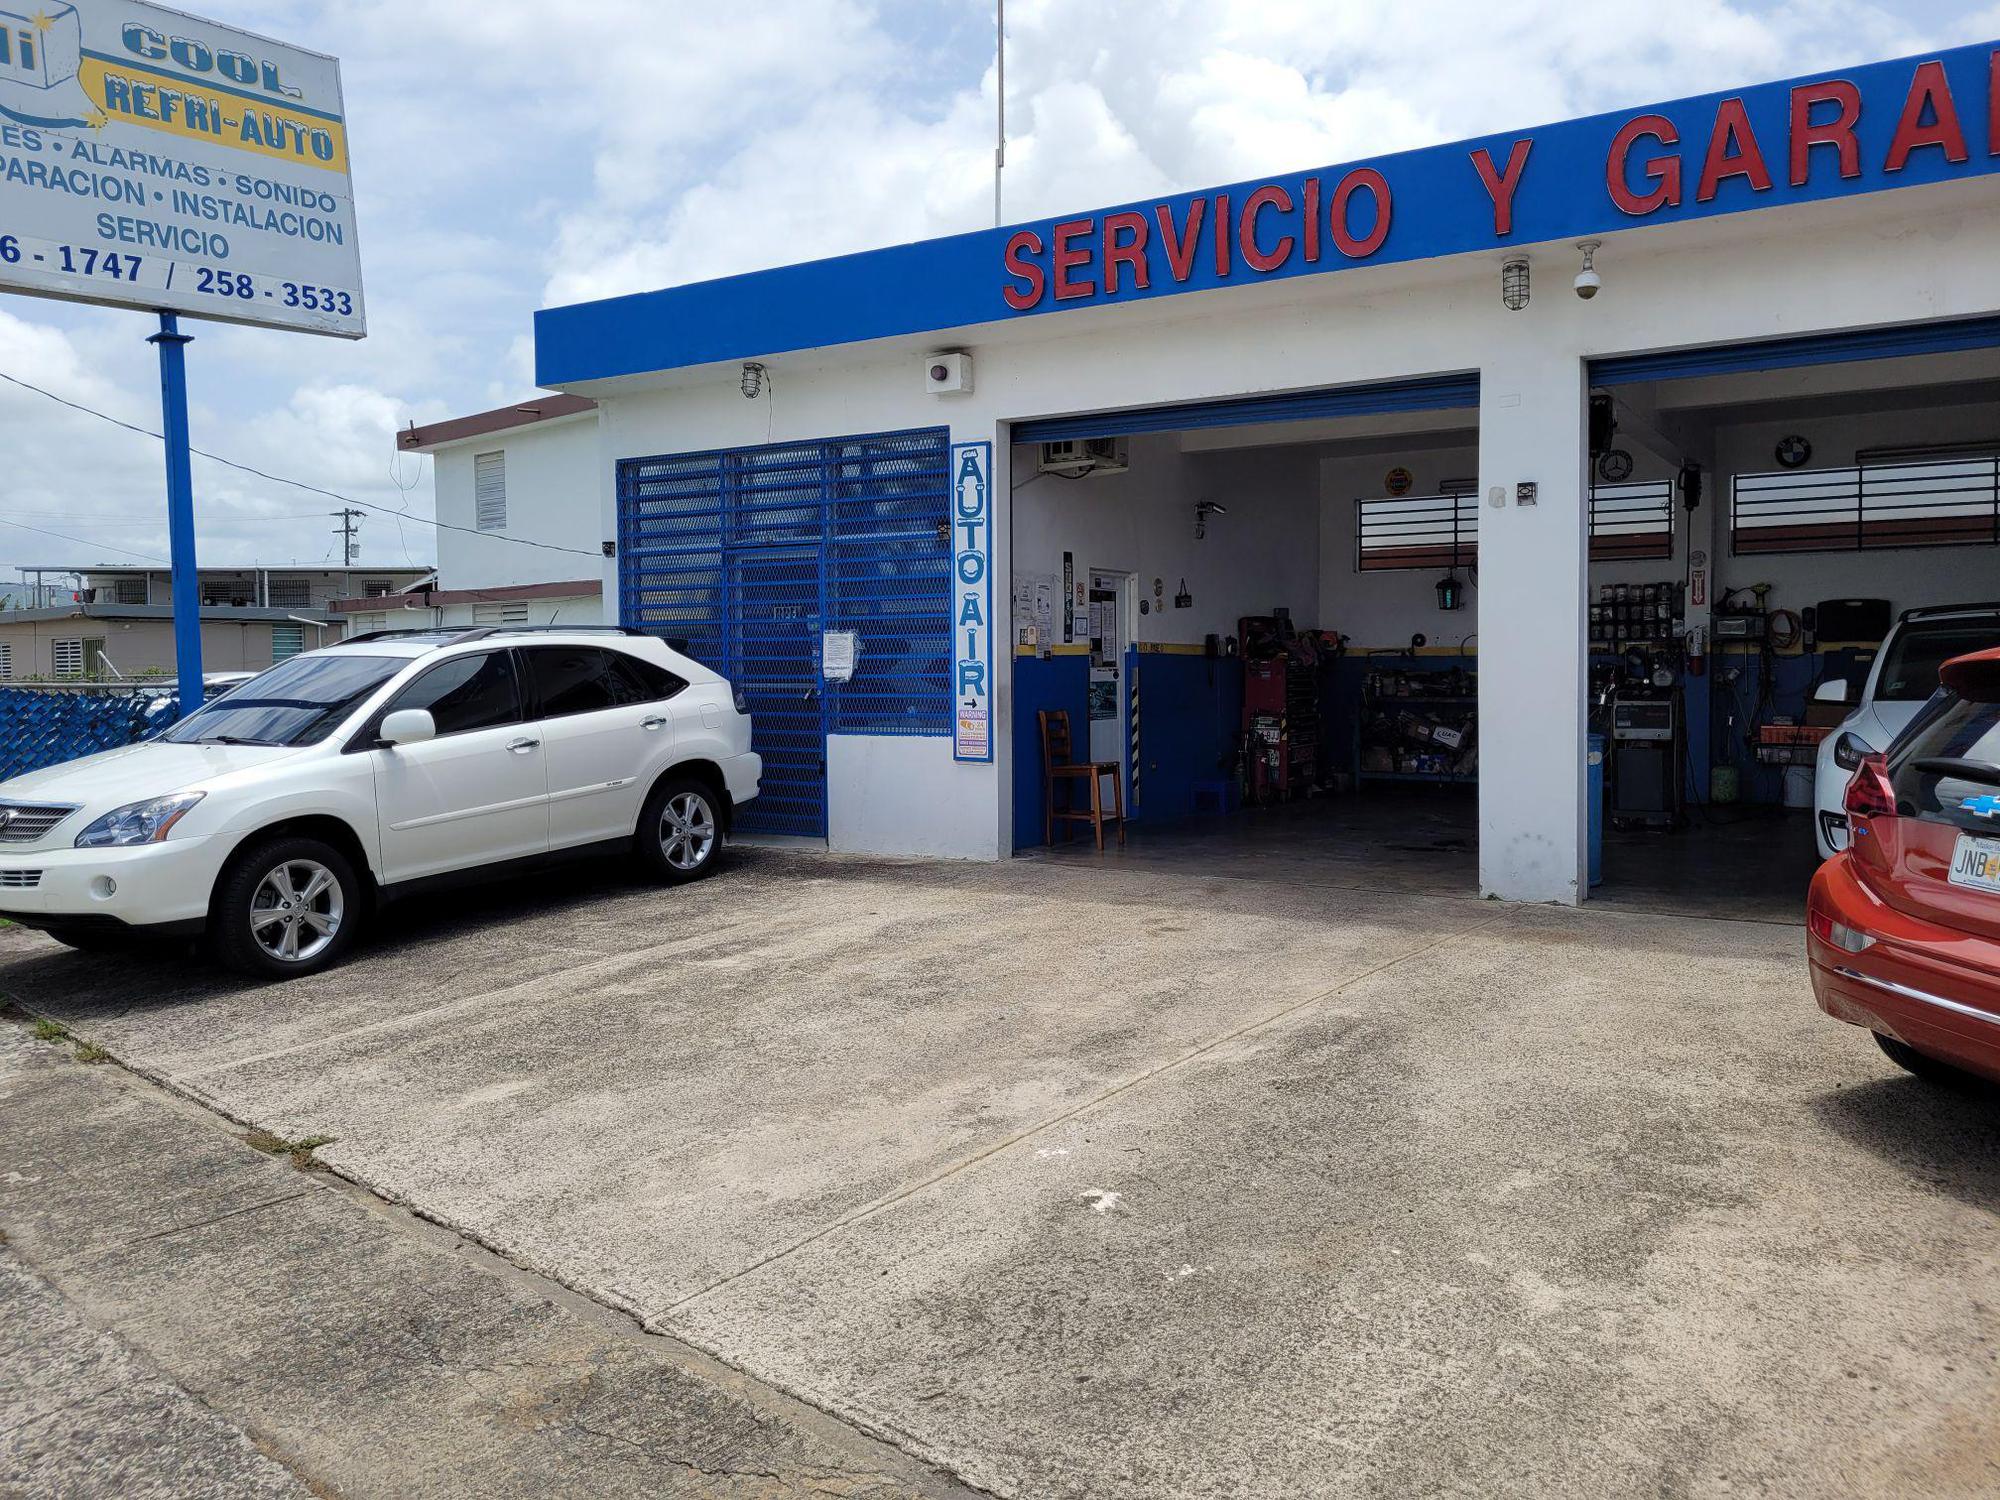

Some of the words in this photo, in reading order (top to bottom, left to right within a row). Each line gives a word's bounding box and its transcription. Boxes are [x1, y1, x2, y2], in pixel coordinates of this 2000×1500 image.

[122, 22, 302, 98] COOL
[104, 72, 335, 161] REFRI-AUTO
[1, 125, 42, 152] ES
[71, 140, 211, 186] ALARMAS
[236, 175, 337, 213] SONIDO
[1002, 167, 1393, 310] SERVICIO
[1469, 138, 1533, 235] Y
[1605, 50, 2000, 216] GARA
[96, 213, 229, 259] SERVICIO
[172, 189, 343, 246] INSTALACION
[59, 245, 142, 282] 1747
[197, 267, 255, 299] 258
[282, 282, 353, 316] 3533
[956, 449, 985, 584] AUTO
[958, 591, 985, 696] AIR
[960, 711, 986, 719] WARNING
[1955, 850, 1988, 877] JNB
